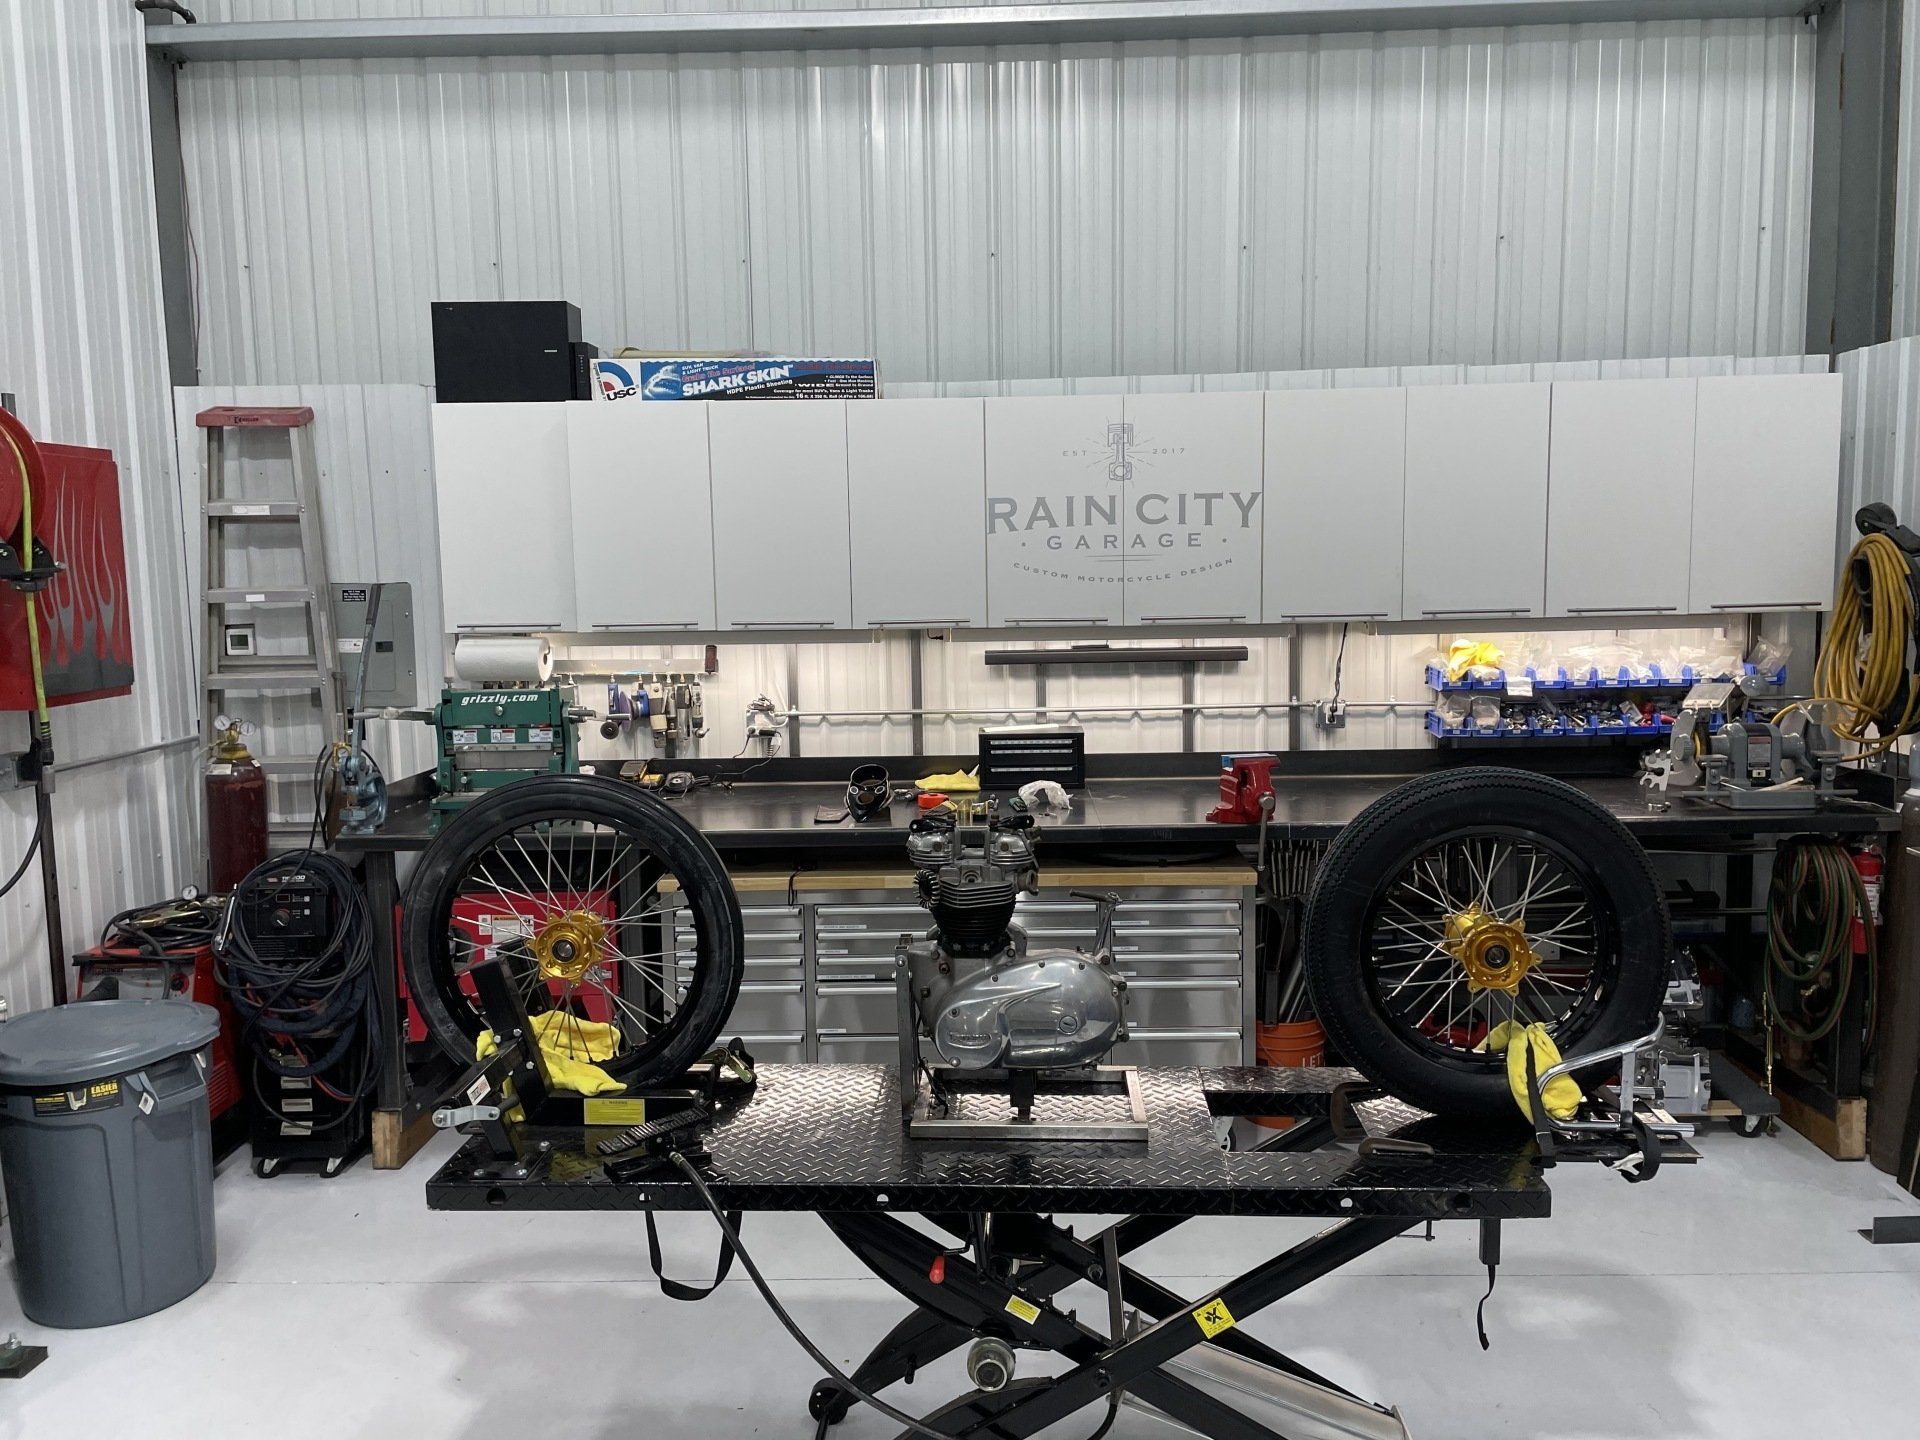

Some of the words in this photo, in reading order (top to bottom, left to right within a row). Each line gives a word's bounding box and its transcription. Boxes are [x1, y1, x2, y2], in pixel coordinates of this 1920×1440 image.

[682, 373, 746, 396] SHARK
[746, 364, 790, 384] SKIN
[726, 387, 743, 395] HDPE
[744, 382, 765, 392] Plastic
[766, 379, 793, 388] Sheeting
[606, 387, 637, 401] USC
[1152, 447, 1185, 455] 2017
[986, 494, 1118, 535] RAIN
[1135, 491, 1263, 529] CITY
[1046, 532, 1202, 550] GARAGE
[1013, 562, 1069, 580] CUSTOM
[1077, 573, 1172, 583] MOTORCYCLE
[1180, 558, 1233, 577] DESIGN
[460, 693, 539, 706] grizzly.com
[90, 1082, 118, 1095] EASIER
